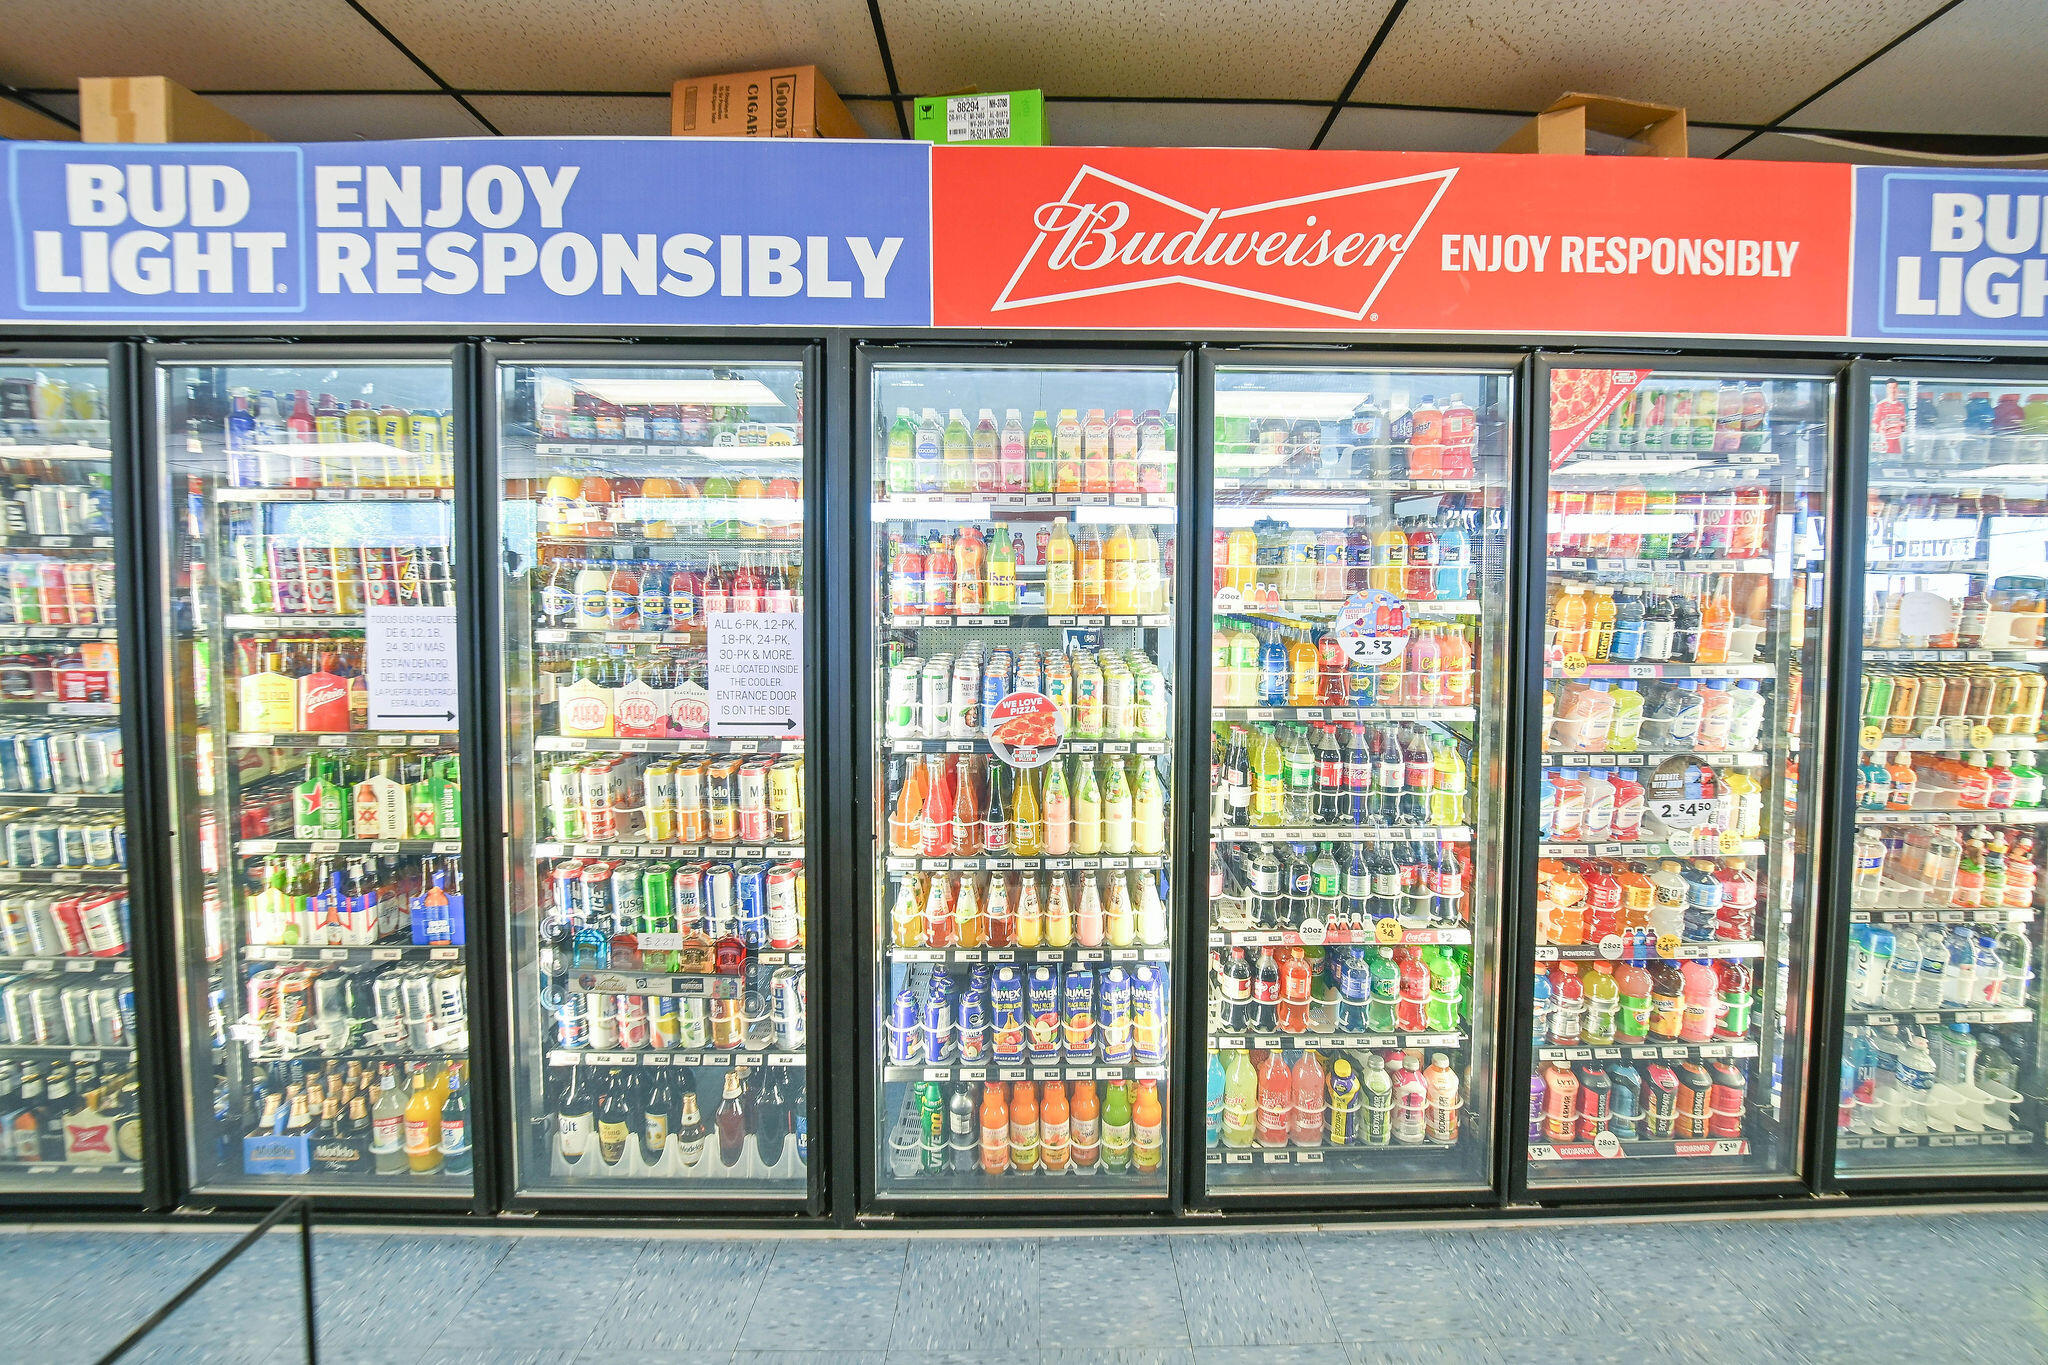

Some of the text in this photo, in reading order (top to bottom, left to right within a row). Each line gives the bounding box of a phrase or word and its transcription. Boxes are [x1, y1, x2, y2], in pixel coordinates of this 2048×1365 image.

[776, 81, 790, 129] GOOD
[66, 164, 250, 228] BUD
[315, 165, 581, 229] ENJOY
[1930, 192, 2048, 254] BU
[1033, 200, 1405, 272] Budweiser
[35, 230, 286, 294] LIGHT
[1441, 234, 1800, 278] ENJOY RESPONSIBLY
[317, 231, 904, 299] RESPONSIBLY
[1571, 430, 1586, 446] YOUR
[1596, 404, 1612, 420] PIZZA
[714, 619, 798, 631] ALL 6-PK, 12-PK,
[721, 634, 791, 646] 18-PK, 24-PK,
[719, 649, 795, 660] 30-PK & MORE.
[1354, 640, 1366, 656] 2
[1373, 639, 1392, 656] $3
[714, 664, 799, 674] ARE LOCATED INSIDE
[730, 677, 783, 687] THE COOLER.
[716, 691, 797, 701] ENTRANCE DOOR
[1002, 697, 1043, 709] WE LOVE
[721, 706, 793, 716] IS ON THE SIDE.
[1010, 707, 1040, 716] PIZZA.
[1661, 804, 1672, 818] 2
[1382, 929, 1395, 939] $4
